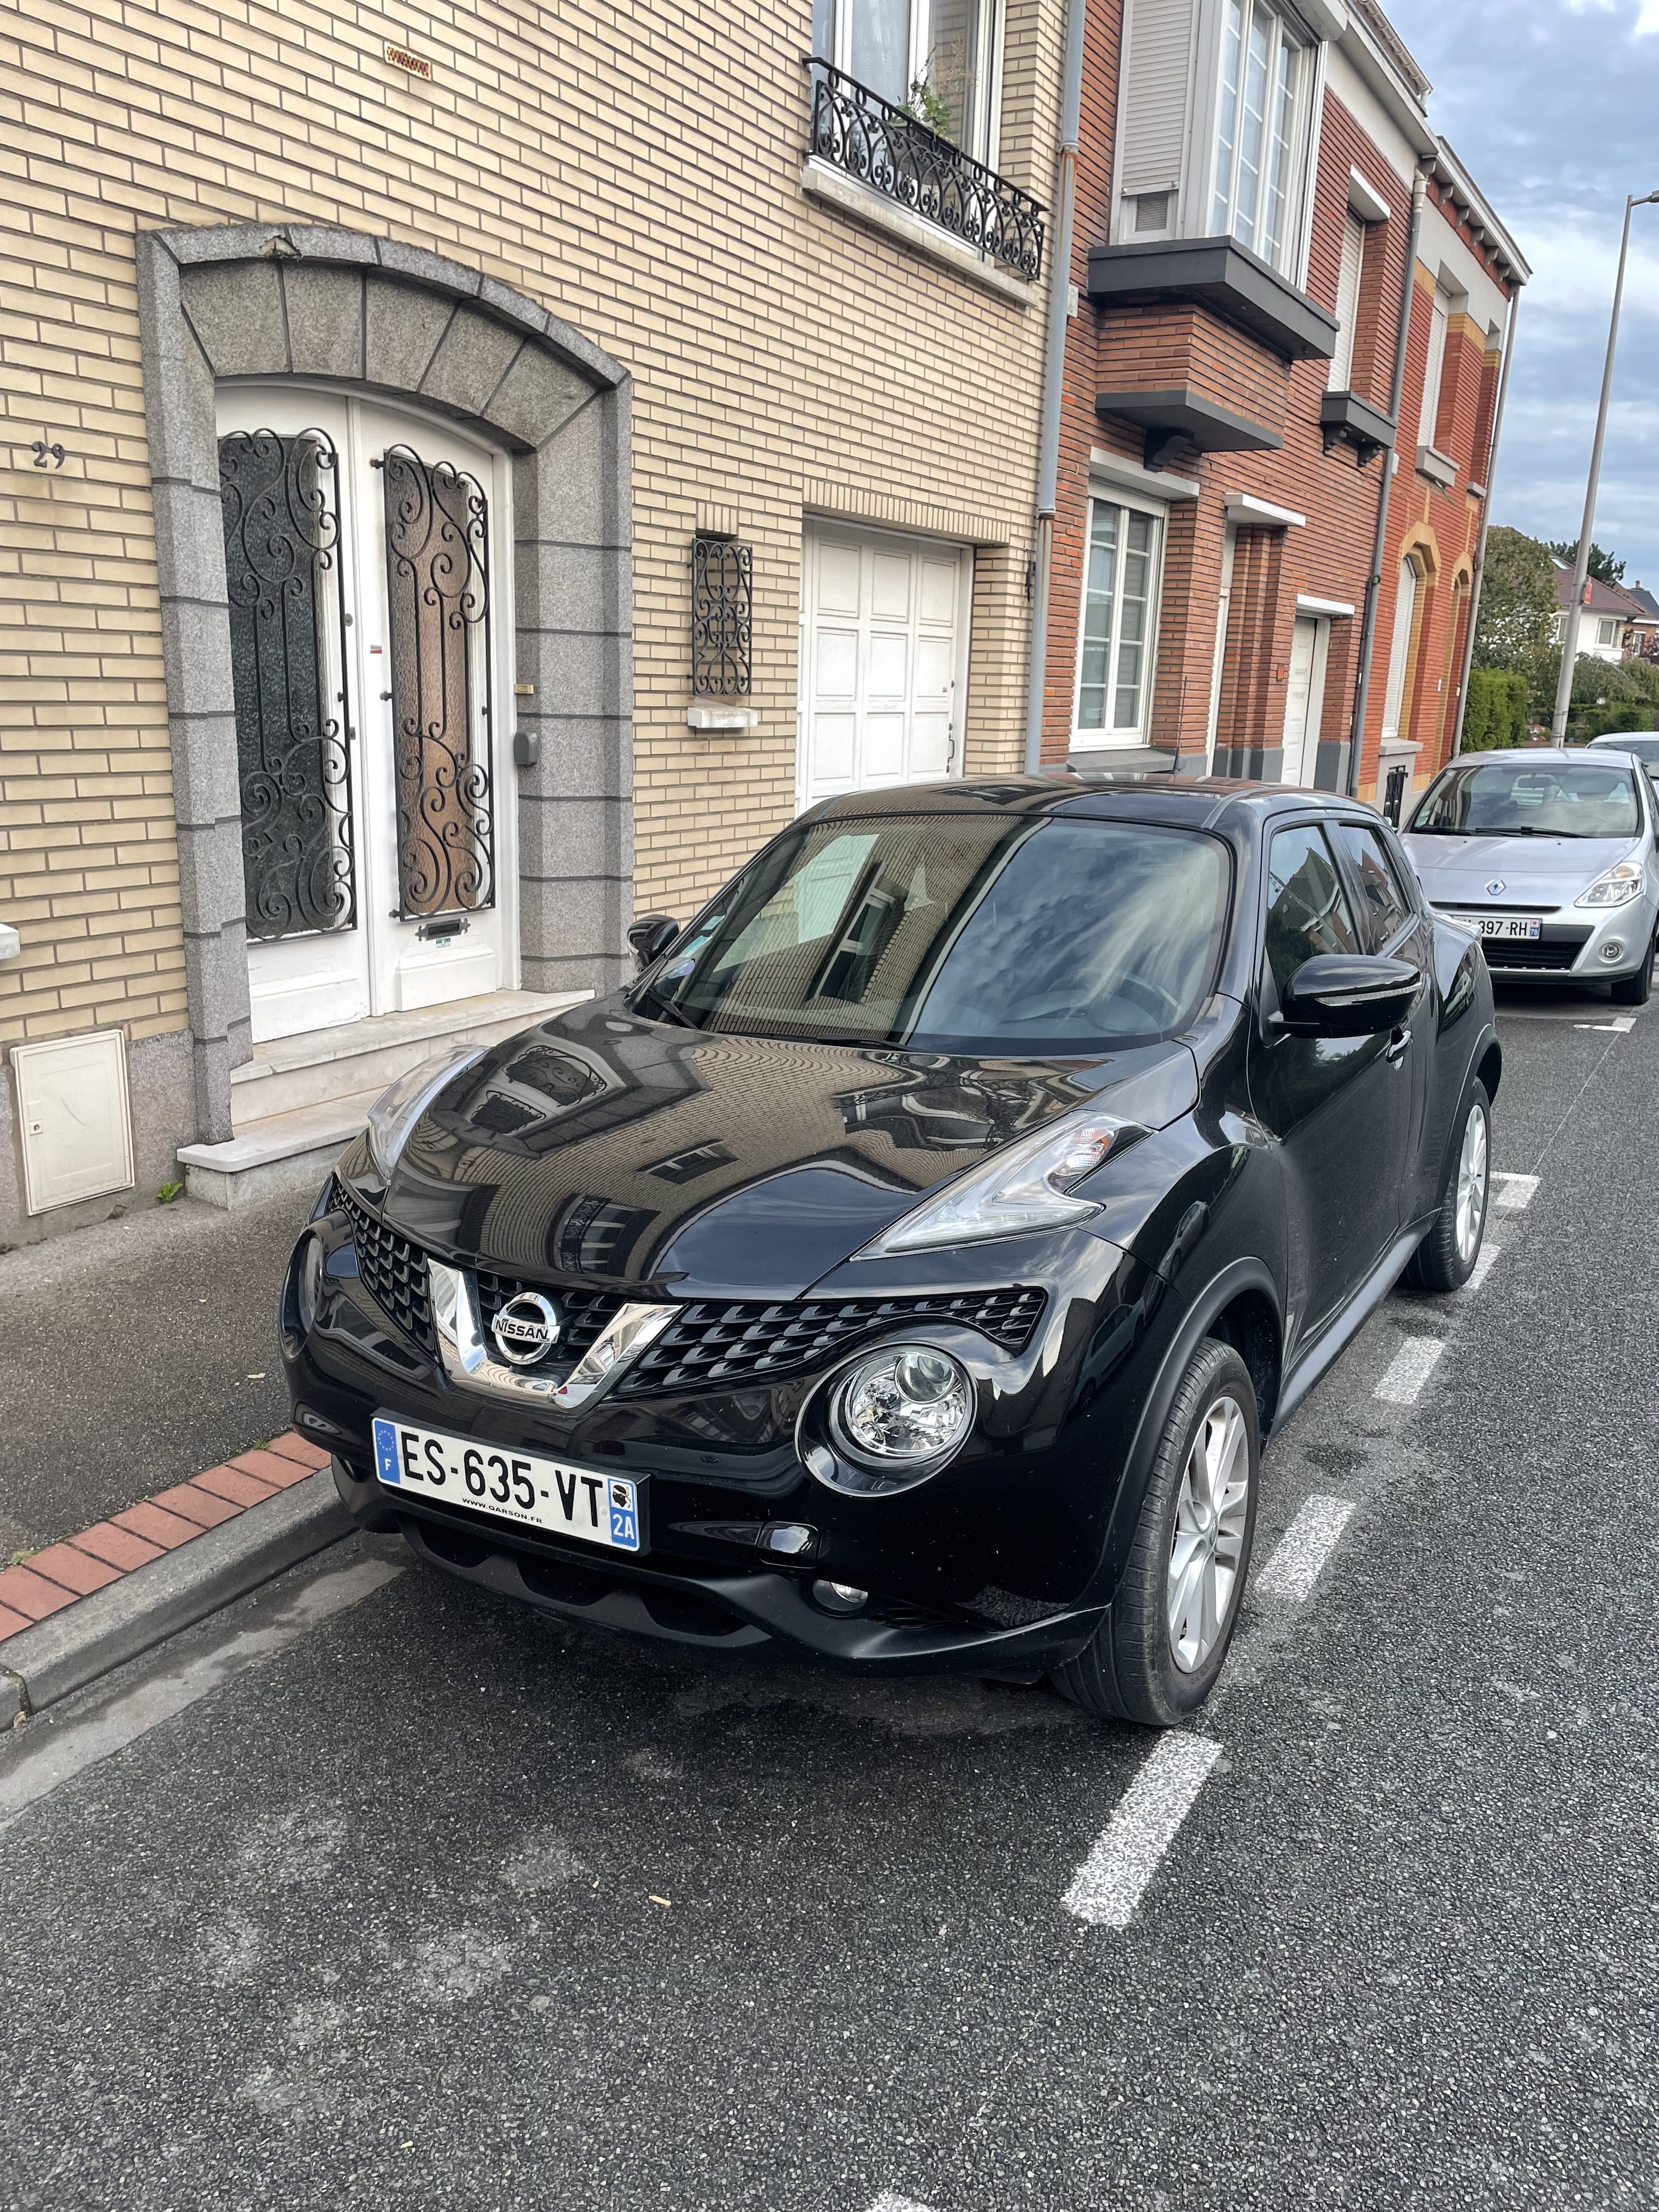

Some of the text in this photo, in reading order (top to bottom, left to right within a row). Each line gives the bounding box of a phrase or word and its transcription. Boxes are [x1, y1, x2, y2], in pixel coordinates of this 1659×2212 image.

[32, 441, 66, 469] 29
[495, 1320, 548, 1339] NISSAN
[385, 1431, 635, 1539] F ES-635-VT 2A
[462, 1498, 543, 1523] WWW.QARSON.FR
